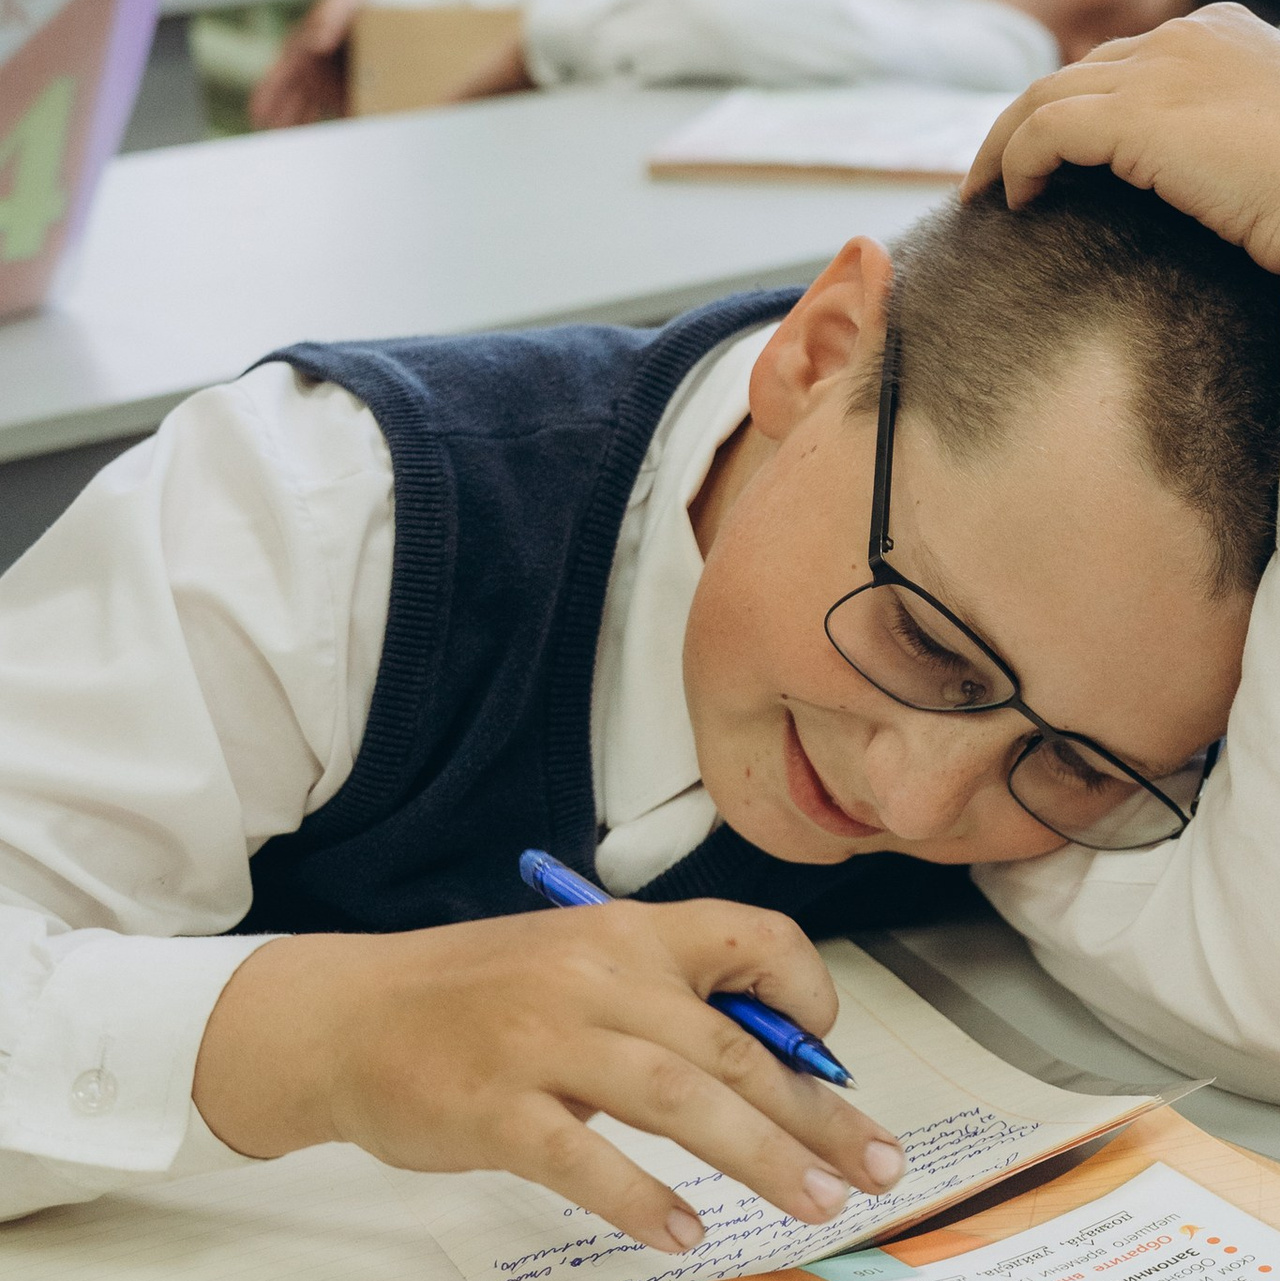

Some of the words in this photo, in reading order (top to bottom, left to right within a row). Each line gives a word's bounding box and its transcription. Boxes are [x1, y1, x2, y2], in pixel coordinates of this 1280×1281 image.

[1108, 1213, 1182, 1249] шедшего
[1038, 1247, 1108, 1279] времени
[1092, 1234, 1173, 1272] Обратите
[1216, 1254, 1257, 1277] ском
[852, 1260, 885, 1281] 106
